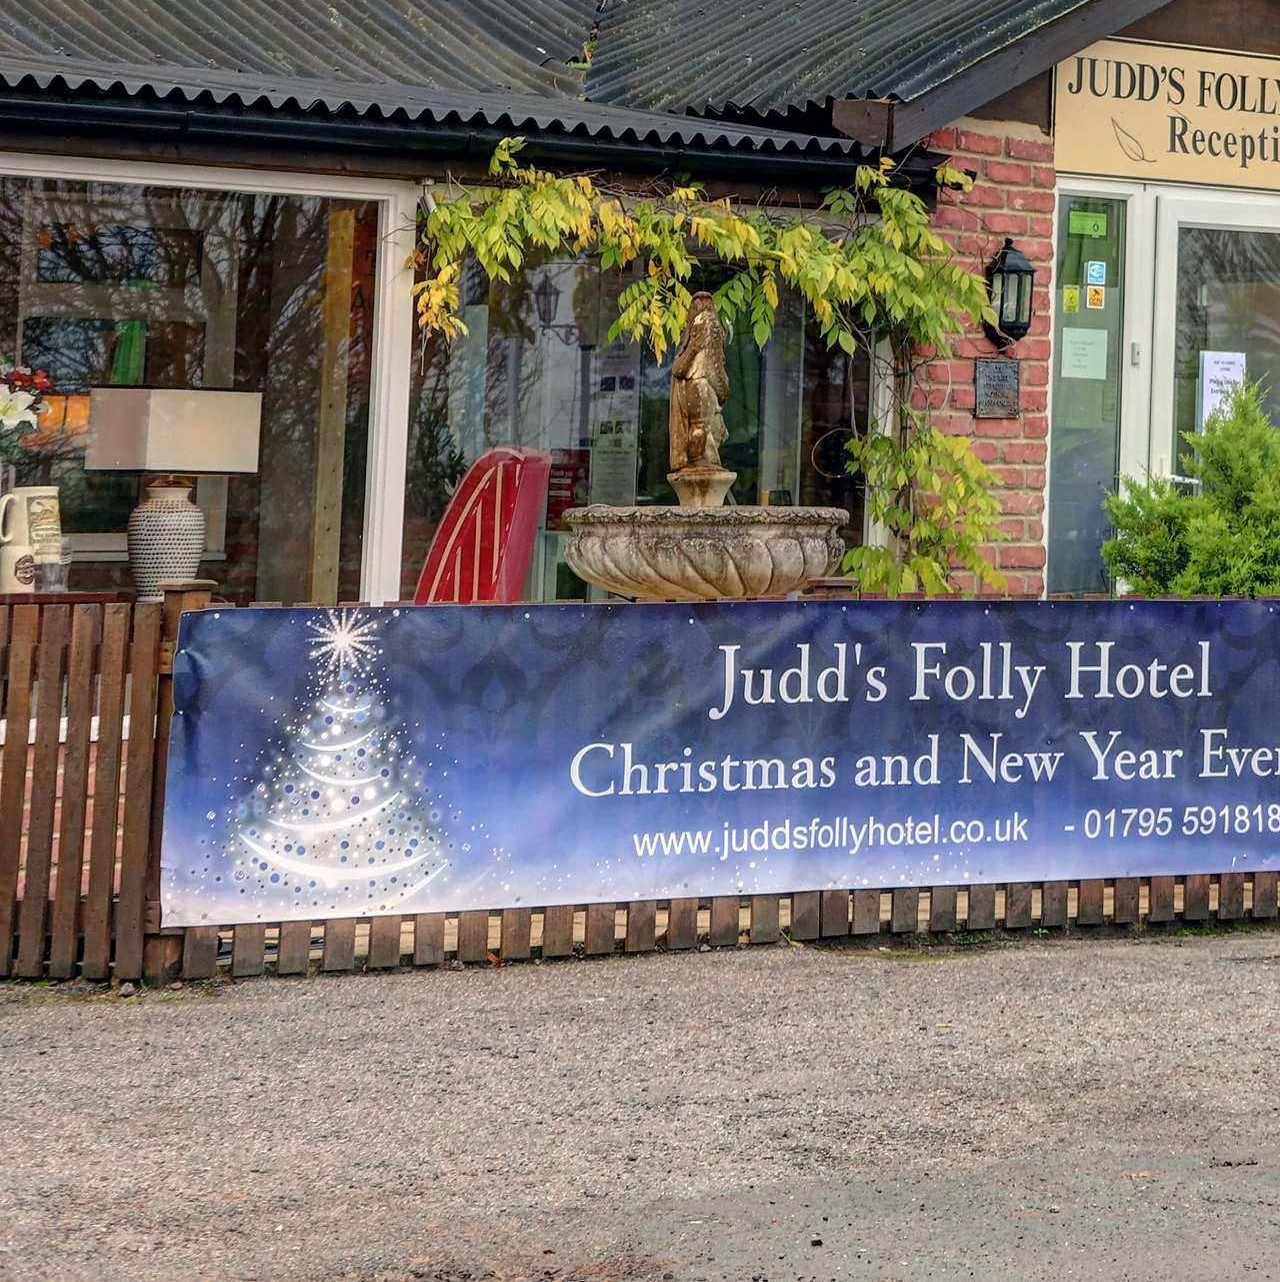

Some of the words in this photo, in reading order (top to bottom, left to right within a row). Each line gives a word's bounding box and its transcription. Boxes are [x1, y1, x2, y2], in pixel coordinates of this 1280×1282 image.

[1067, 56, 1185, 105] JUDD'S
[708, 642, 888, 720] Judd's
[908, 641, 1046, 719] Folly
[1064, 640, 1213, 700] Hotel
[569, 742, 836, 798] Christmas
[854, 734, 941, 787] and
[958, 732, 1064, 784] New
[1079, 730, 1183, 781] Year
[632, 811, 1029, 861] www.juddsfollyhotel.co.uk
[1083, 806, 1173, 839] 01795
